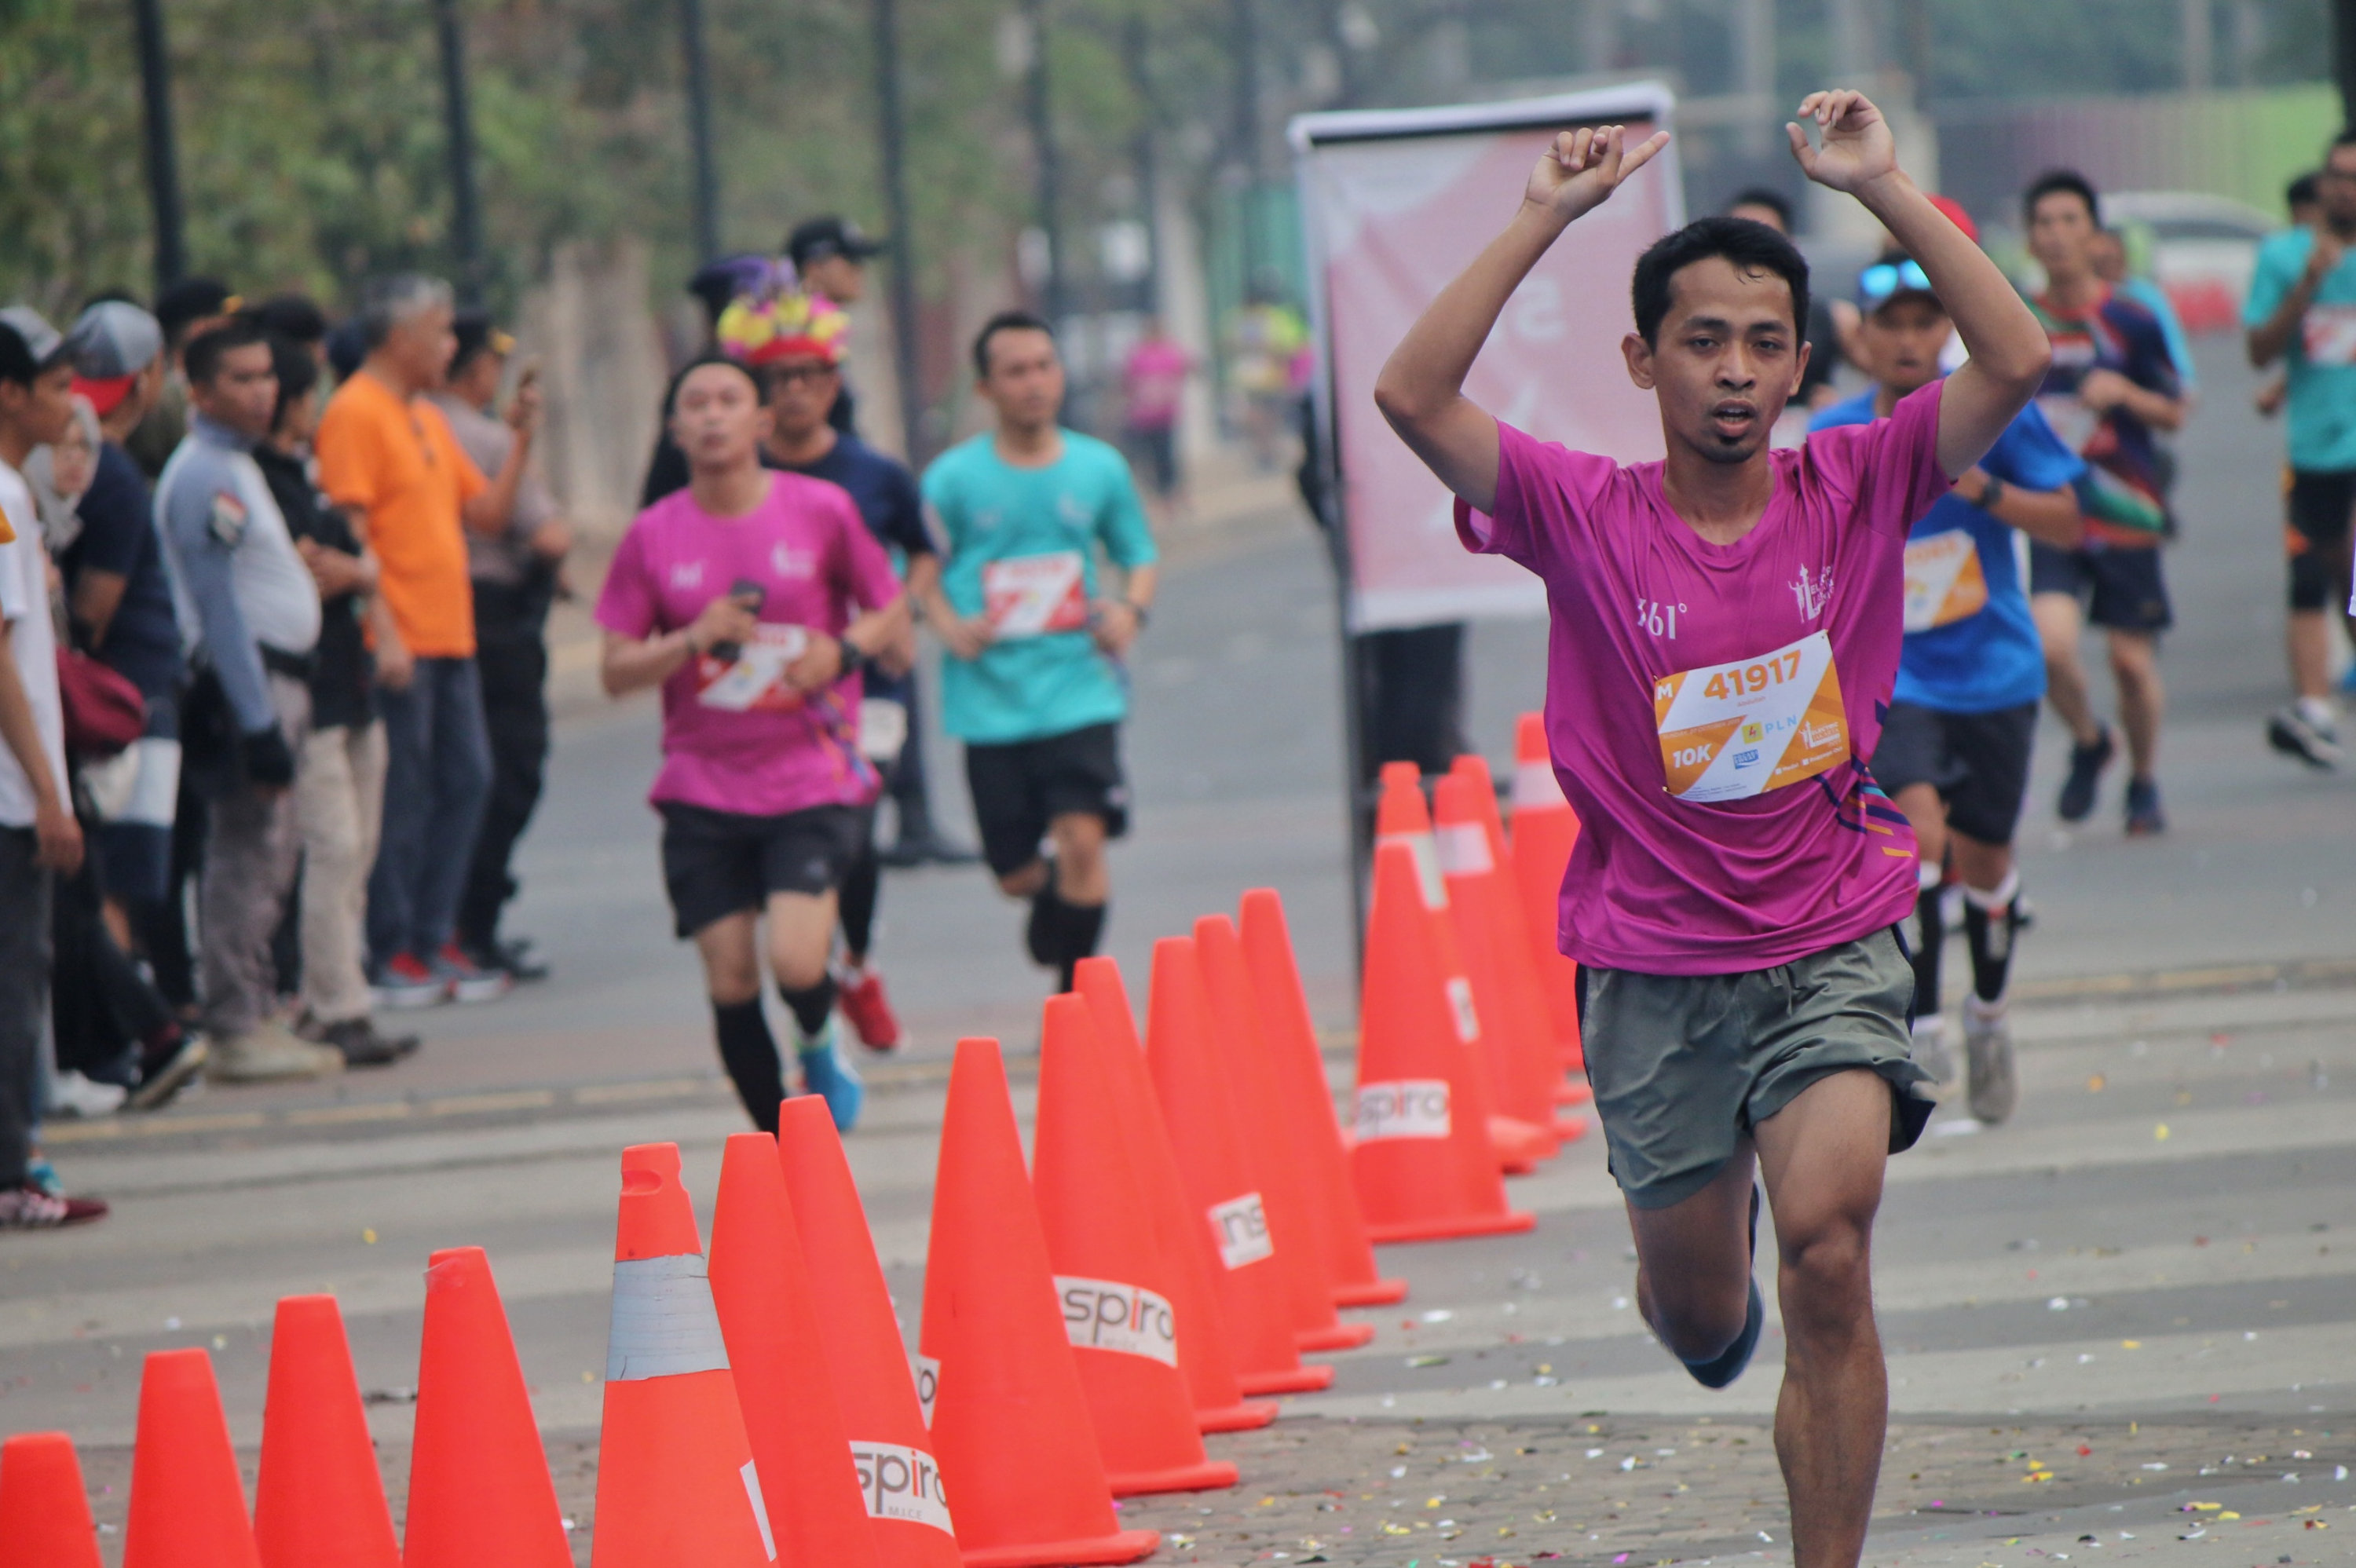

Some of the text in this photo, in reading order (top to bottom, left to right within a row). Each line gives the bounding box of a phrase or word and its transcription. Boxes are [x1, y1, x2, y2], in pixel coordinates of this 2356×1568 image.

[1704, 649, 1802, 700] 41917
[1656, 682, 1674, 700] M
[1765, 714, 1798, 734] PLN
[1672, 743, 1713, 769] 10K
